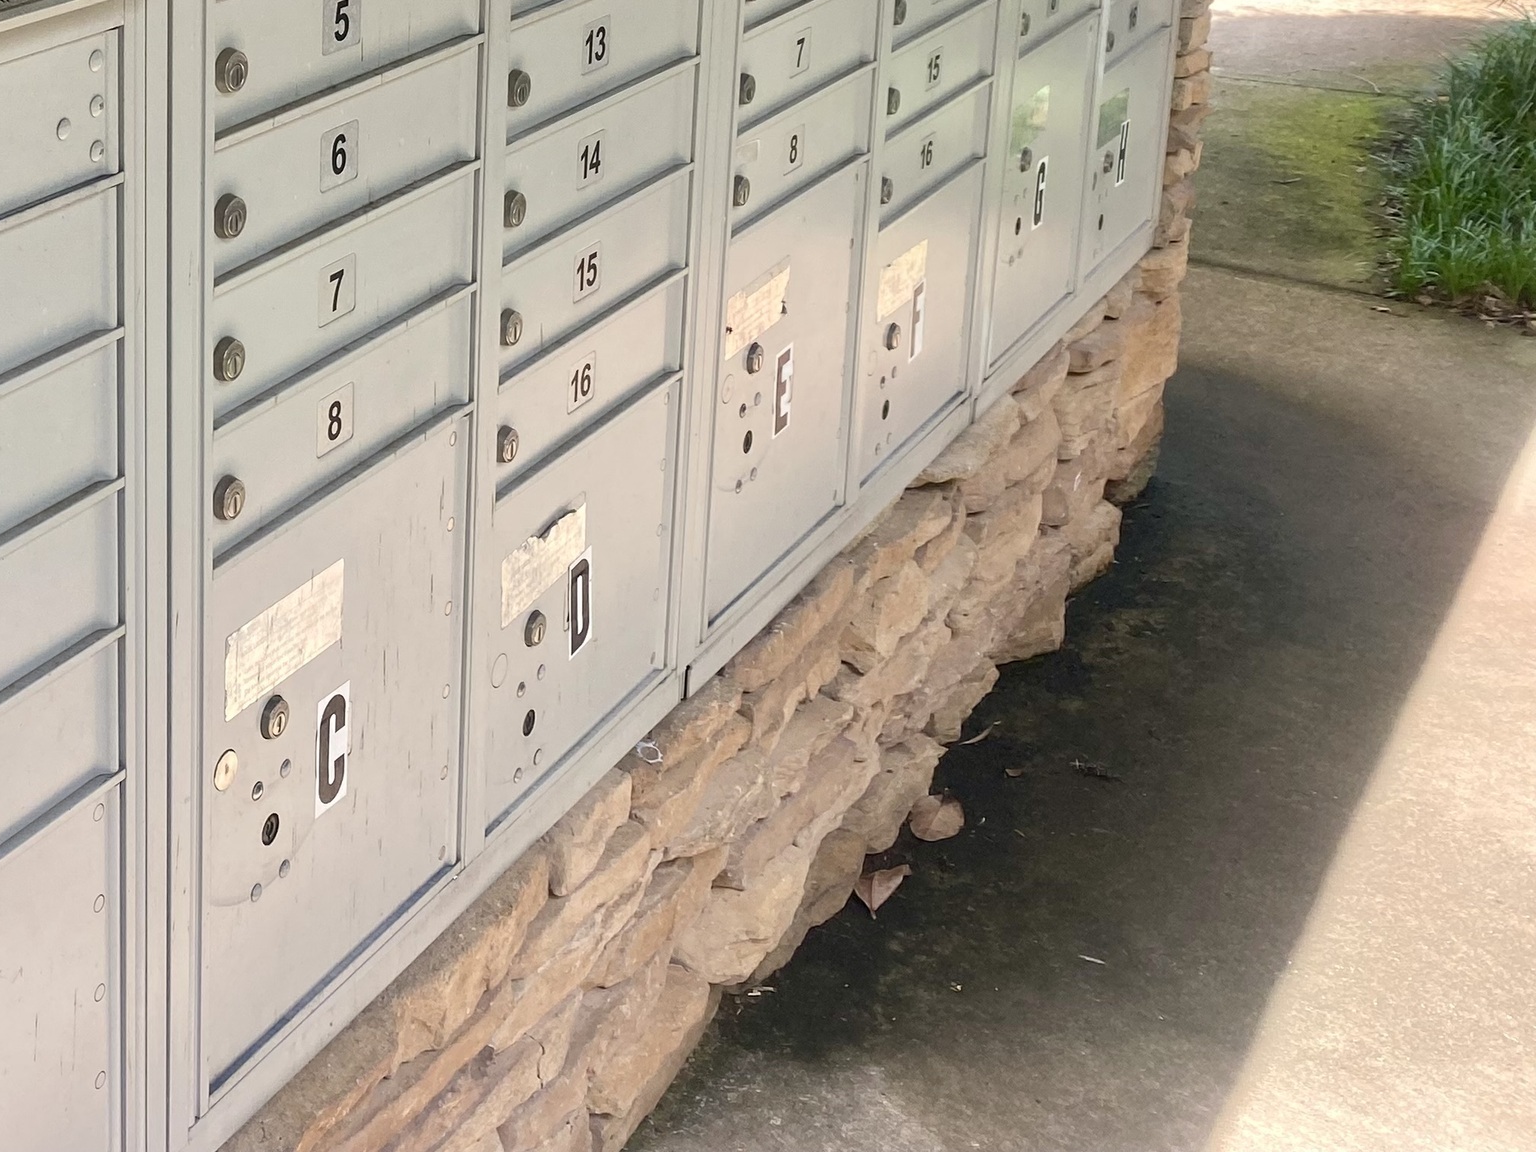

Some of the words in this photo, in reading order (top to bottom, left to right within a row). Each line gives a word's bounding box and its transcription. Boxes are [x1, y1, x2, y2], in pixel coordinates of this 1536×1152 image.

[335, 0, 349, 41] 5
[586, 27, 605, 64] 13
[796, 37, 806, 68] 7
[927, 54, 941, 84] 15
[332, 134, 346, 175] 6
[581, 140, 600, 179] 14
[789, 134, 798, 164] 8
[920, 140, 934, 170] 16
[1116, 121, 1130, 183] H
[1034, 162, 1046, 226] G
[330, 269, 344, 312] 7
[577, 252, 597, 291] 15
[910, 281, 924, 358] F
[571, 364, 591, 402] 16
[774, 348, 791, 436] E
[327, 400, 342, 441] 8
[570, 558, 590, 656] D
[319, 694, 346, 804] C
